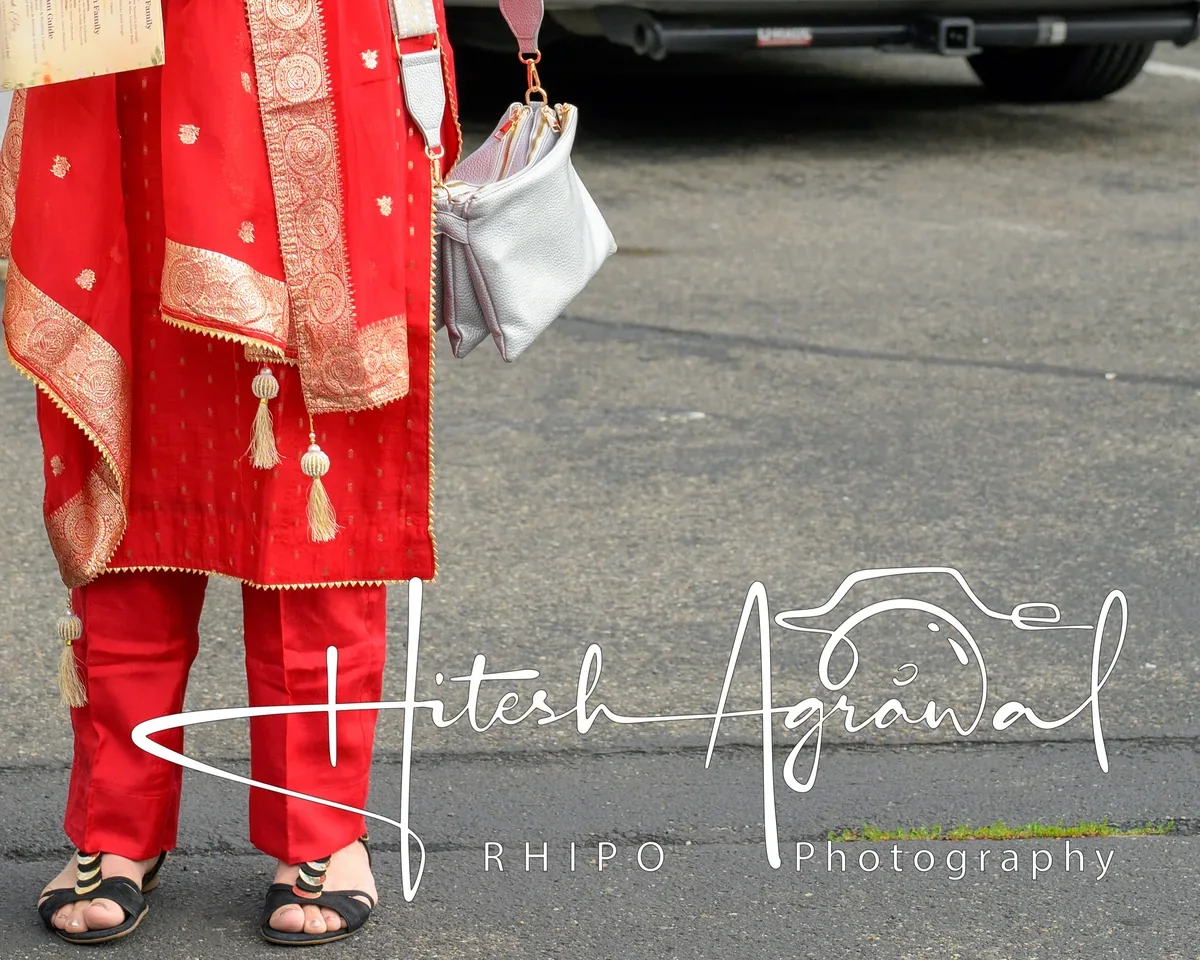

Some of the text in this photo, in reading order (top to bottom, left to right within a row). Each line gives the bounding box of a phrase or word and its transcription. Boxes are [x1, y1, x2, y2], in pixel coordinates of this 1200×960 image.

[46, 12, 55, 40] Guide
[91, 4, 101, 34] Family
[143, 0, 153, 31] Family
